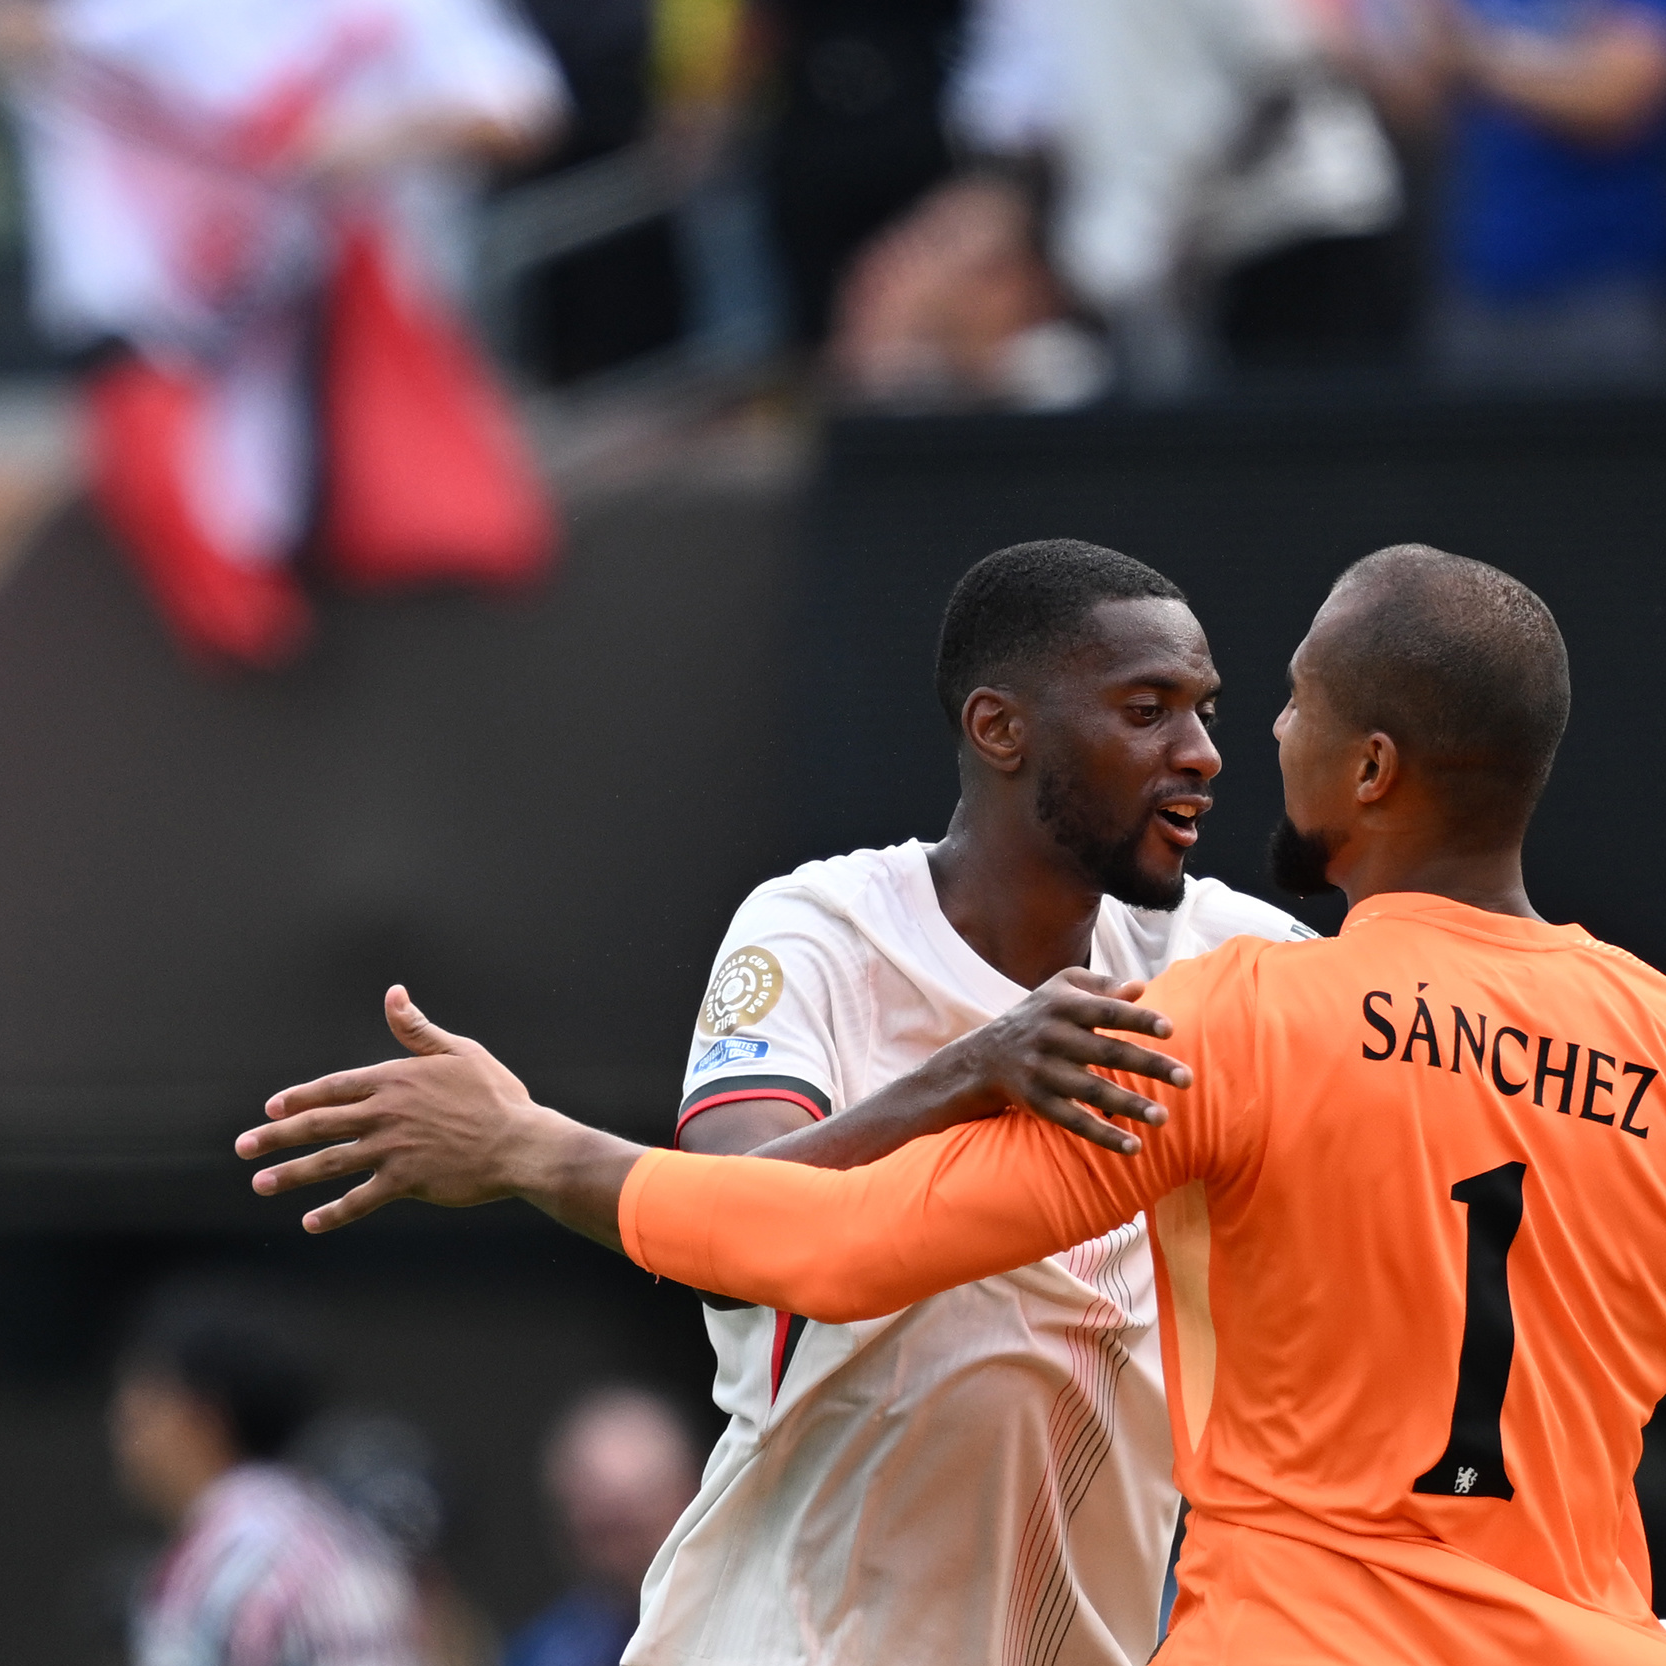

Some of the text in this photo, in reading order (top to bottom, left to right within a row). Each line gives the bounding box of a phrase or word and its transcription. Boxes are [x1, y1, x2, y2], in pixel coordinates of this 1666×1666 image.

[712, 954, 747, 990] WORLD
[748, 955, 769, 971] CUP
[746, 991, 770, 1014] USA
[713, 1013, 737, 1033] FIFA
[725, 1039, 759, 1052] UNITES
[1362, 982, 1659, 1140] SÁNCHEZ
[1411, 1160, 1528, 1503] 1
